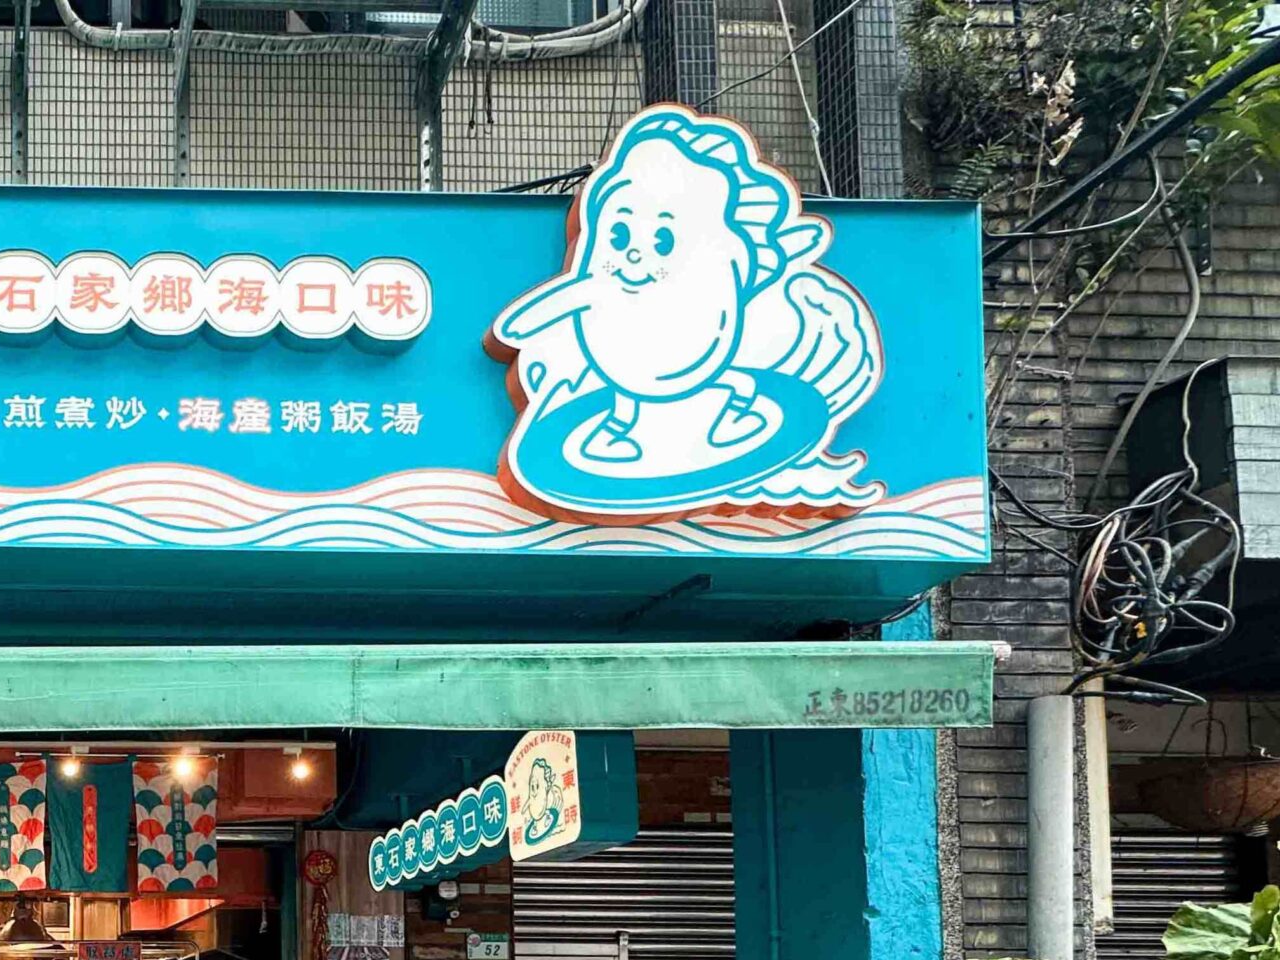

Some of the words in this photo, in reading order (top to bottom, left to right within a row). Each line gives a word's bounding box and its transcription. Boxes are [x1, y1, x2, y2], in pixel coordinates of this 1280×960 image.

[508, 734, 541, 779] EASTONE
[540, 732, 572, 749] OYSTER
[509, 794, 523, 846] 鮮蚵
[562, 768, 578, 825] 東時
[373, 796, 503, 876] 東石家鄉海口味
[484, 943, 502, 957] 52
